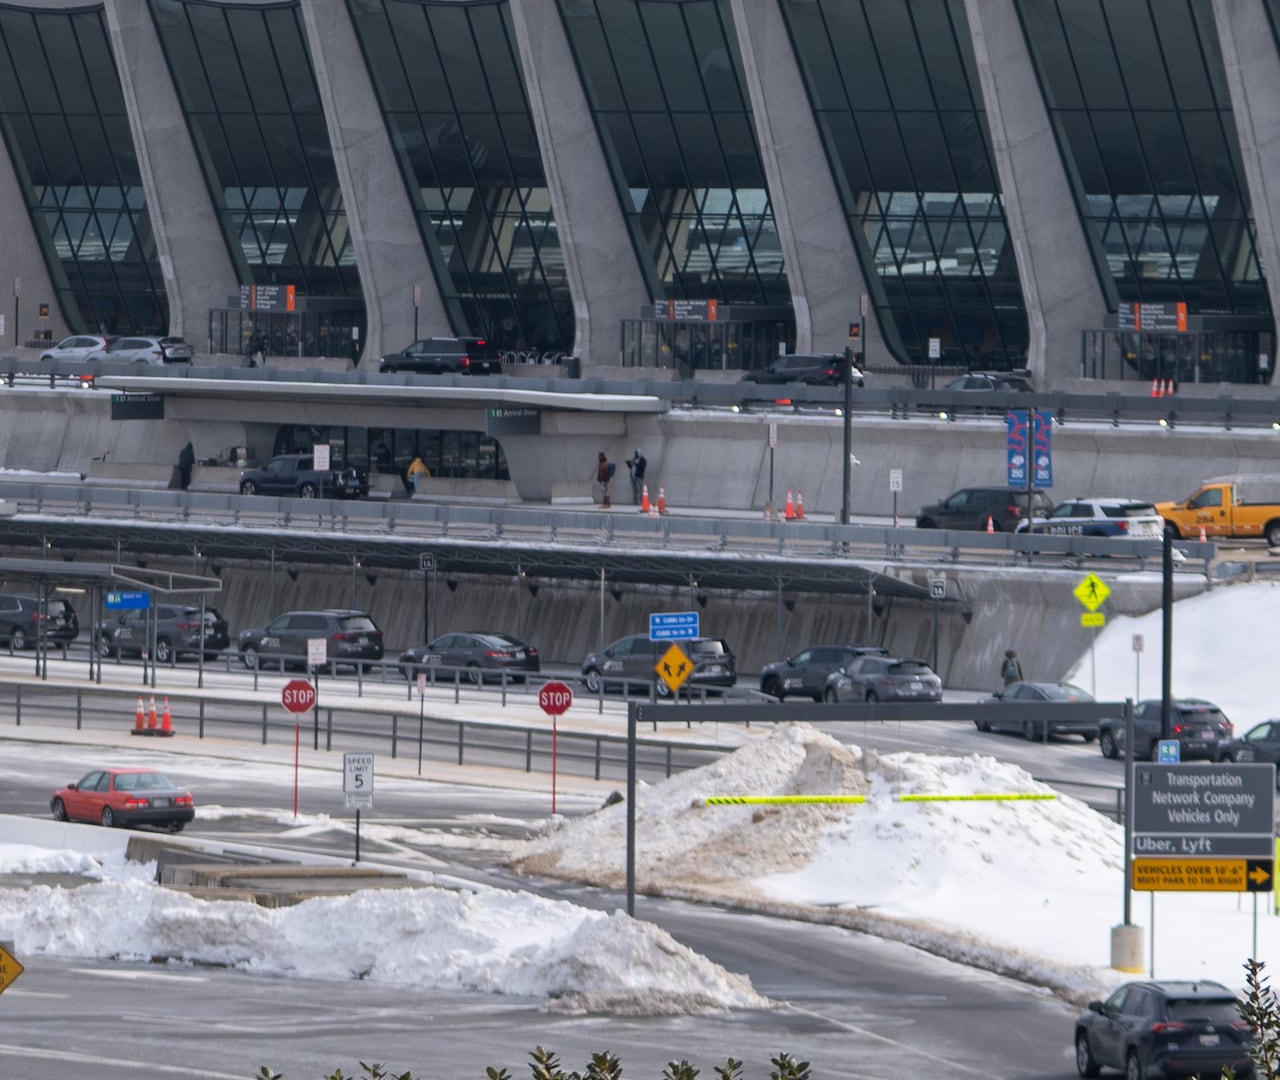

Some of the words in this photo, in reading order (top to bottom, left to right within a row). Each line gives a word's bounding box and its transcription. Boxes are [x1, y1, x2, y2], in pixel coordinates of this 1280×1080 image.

[504, 408, 522, 416] Arrival
[524, 408, 537, 416] Door
[1050, 525, 1083, 536] POLICE
[284, 689, 314, 704] STOP
[541, 691, 570, 706] STOP
[354, 773, 364, 789] 5
[1167, 772, 1242, 789] Transportation
[1152, 791, 1200, 805] Network
[1204, 791, 1255, 808] Company
[1168, 808, 1211, 824] Vehicles
[1214, 809, 1240, 826] Only
[1136, 838, 1176, 852] Uber,
[1182, 838, 1212, 853] Lyft
[1137, 865, 1183, 875] VEHICLES
[1185, 865, 1211, 875] OVER
[1137, 876, 1160, 884] MUST
[1163, 876, 1185, 884] PARK
[1187, 876, 1198, 885] TO
[1200, 876, 1215, 885] THE
[1217, 876, 1243, 885] RIGHT
